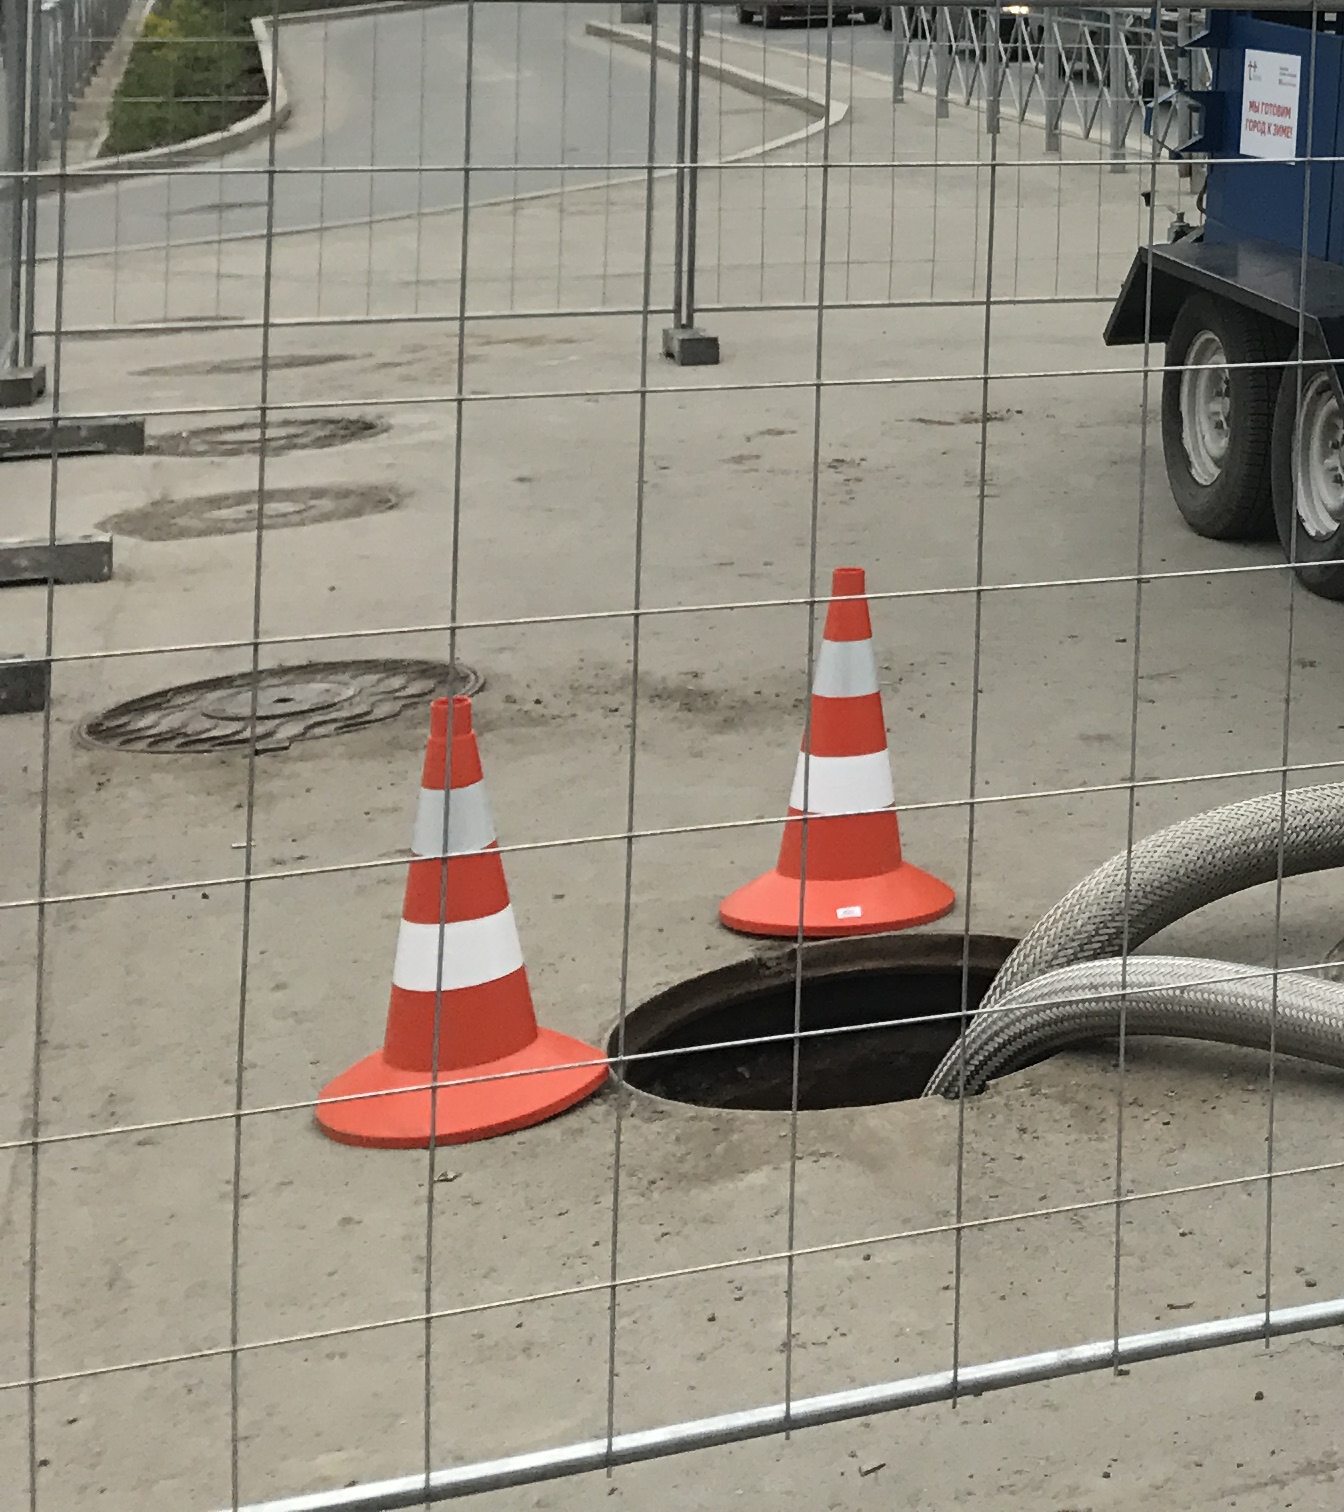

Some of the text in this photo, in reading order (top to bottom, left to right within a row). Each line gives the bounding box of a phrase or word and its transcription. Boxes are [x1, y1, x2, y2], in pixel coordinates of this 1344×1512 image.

[1249, 100, 1292, 119] МЫ ГОТОВИМ
[1245, 118, 1266, 136] ГОРОД
[1273, 123, 1293, 139] ЗИМЕ!
